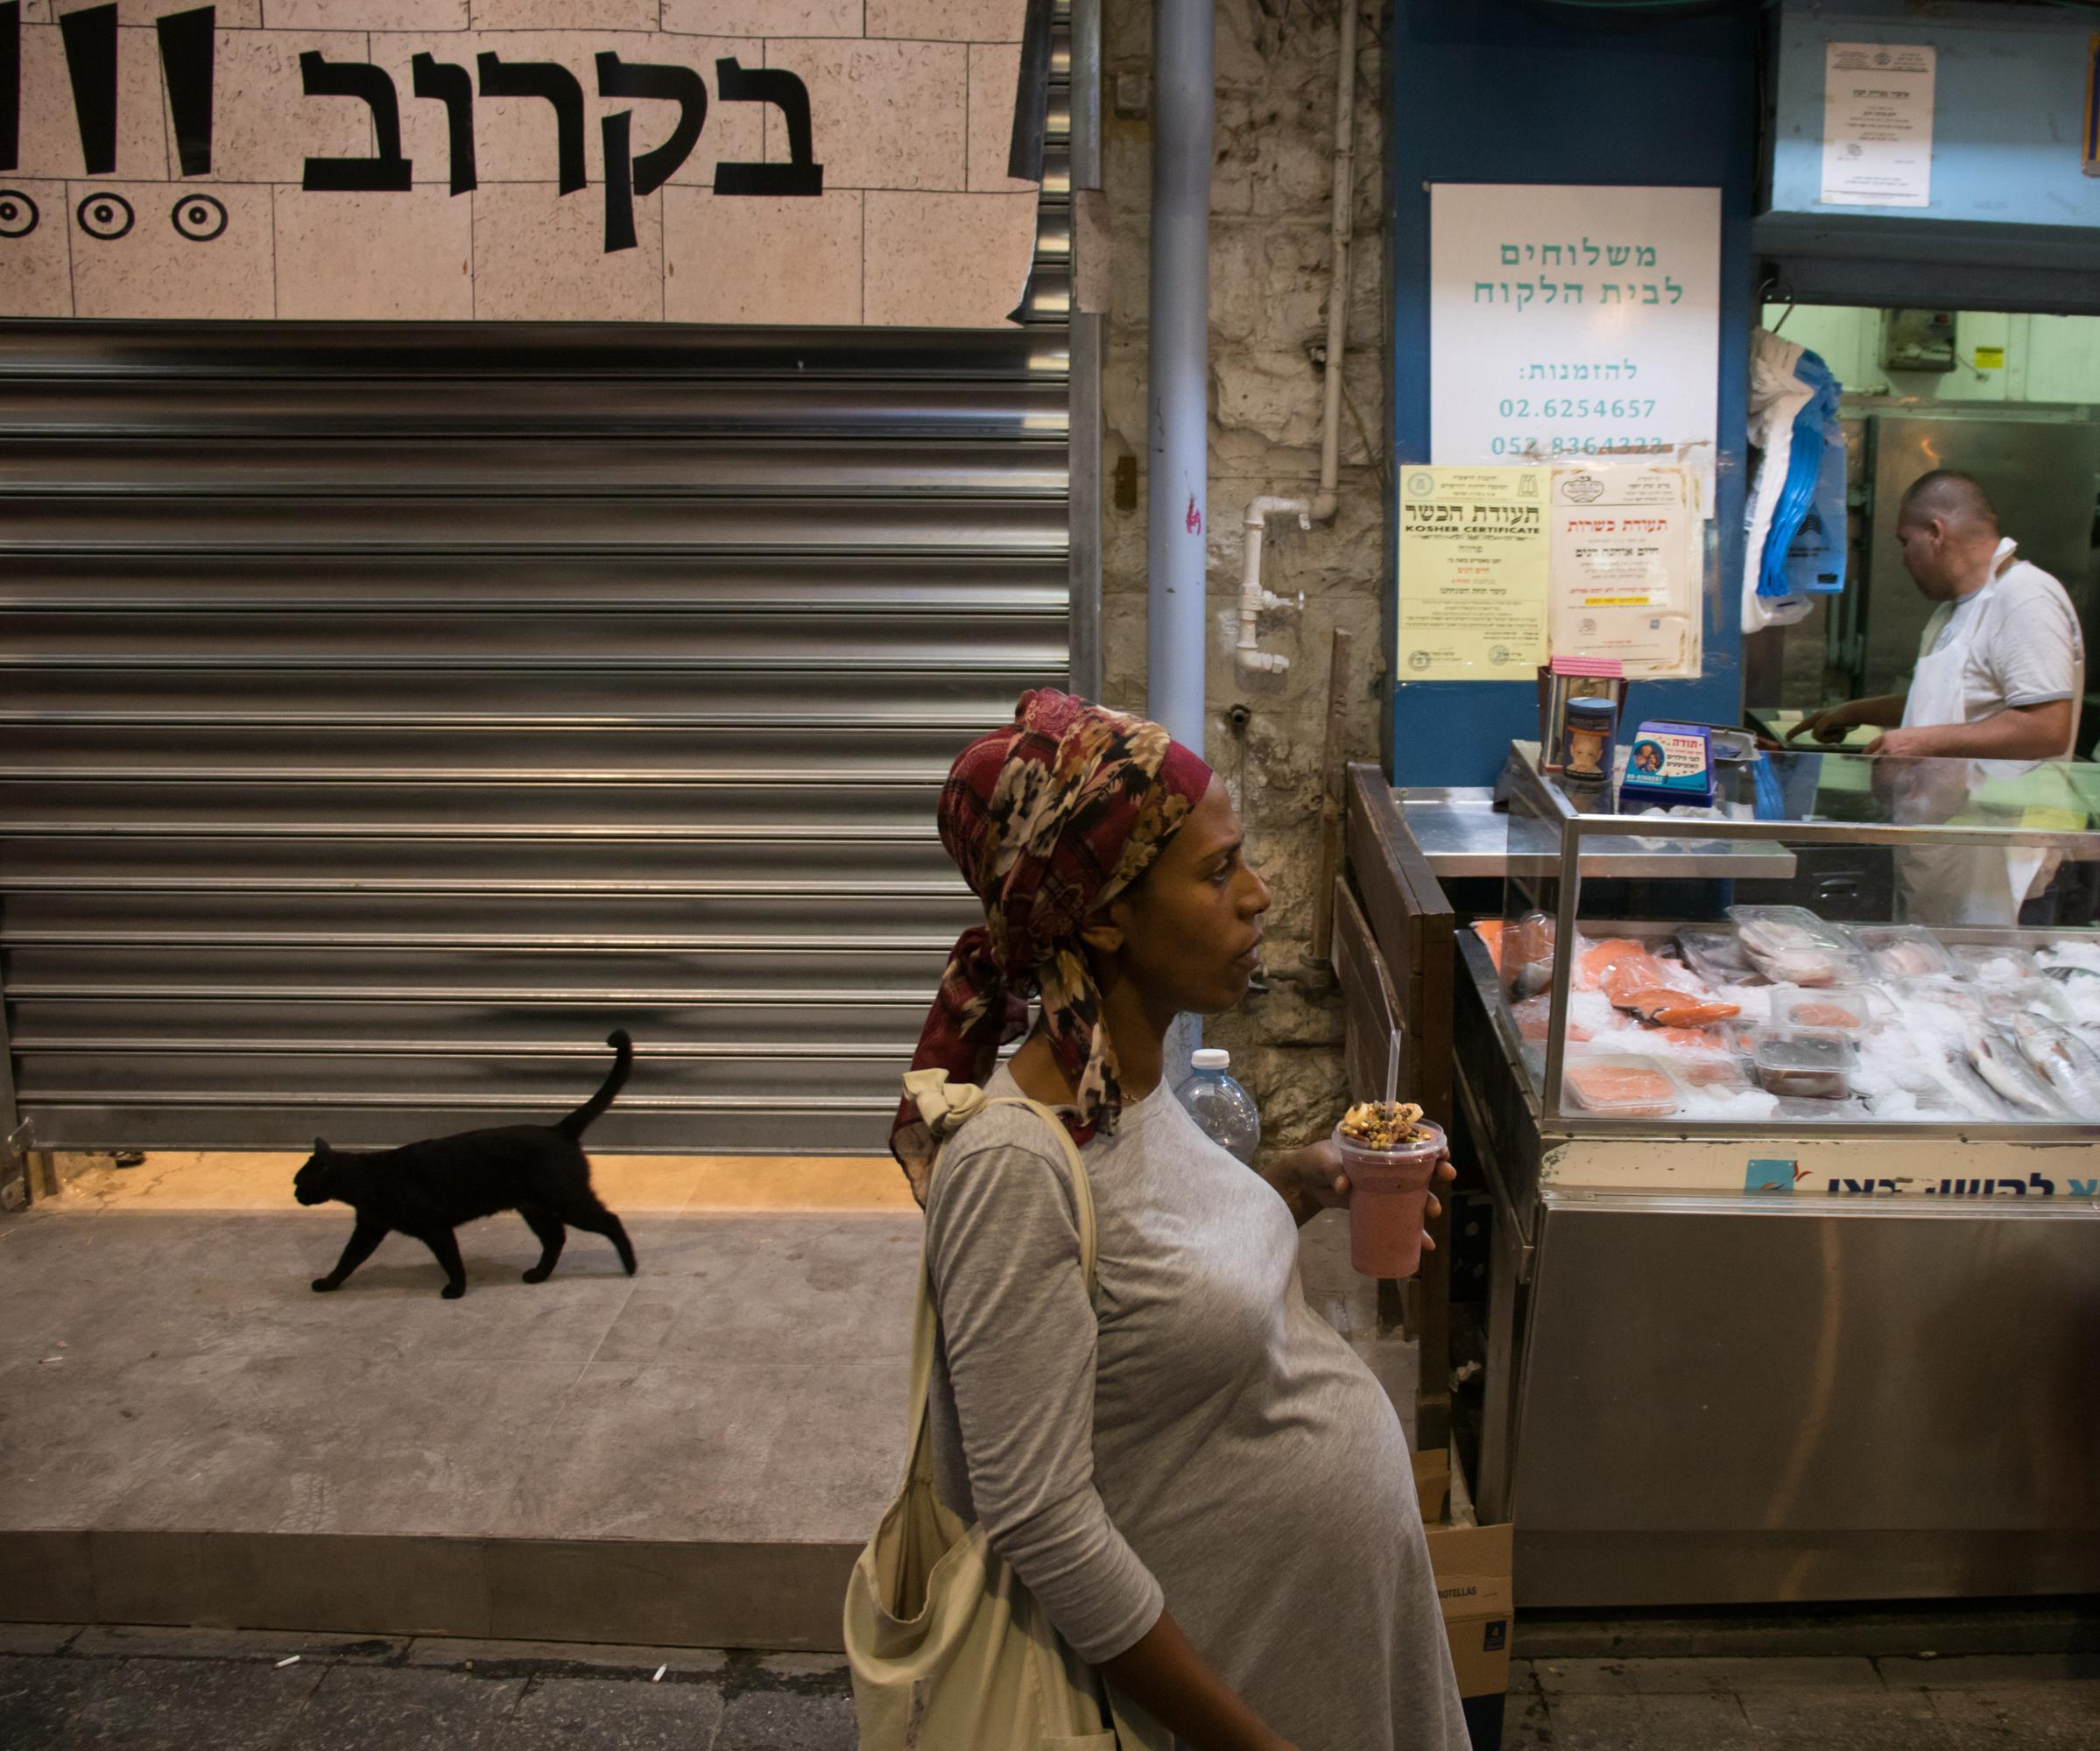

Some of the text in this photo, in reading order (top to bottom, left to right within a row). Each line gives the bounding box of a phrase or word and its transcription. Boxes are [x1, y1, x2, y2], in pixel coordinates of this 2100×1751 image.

[299, 51, 824, 254] בקרוב
[1500, 236, 1657, 267] משלוחים
[1474, 275, 1684, 312] לבית הלקוח
[1519, 359, 1638, 380] להזמנות:
[1498, 399, 1656, 418] 02.6254657
[1405, 504, 1540, 525] תעודת הכשר
[1463, 526, 1540, 535] CERTIFICATE
